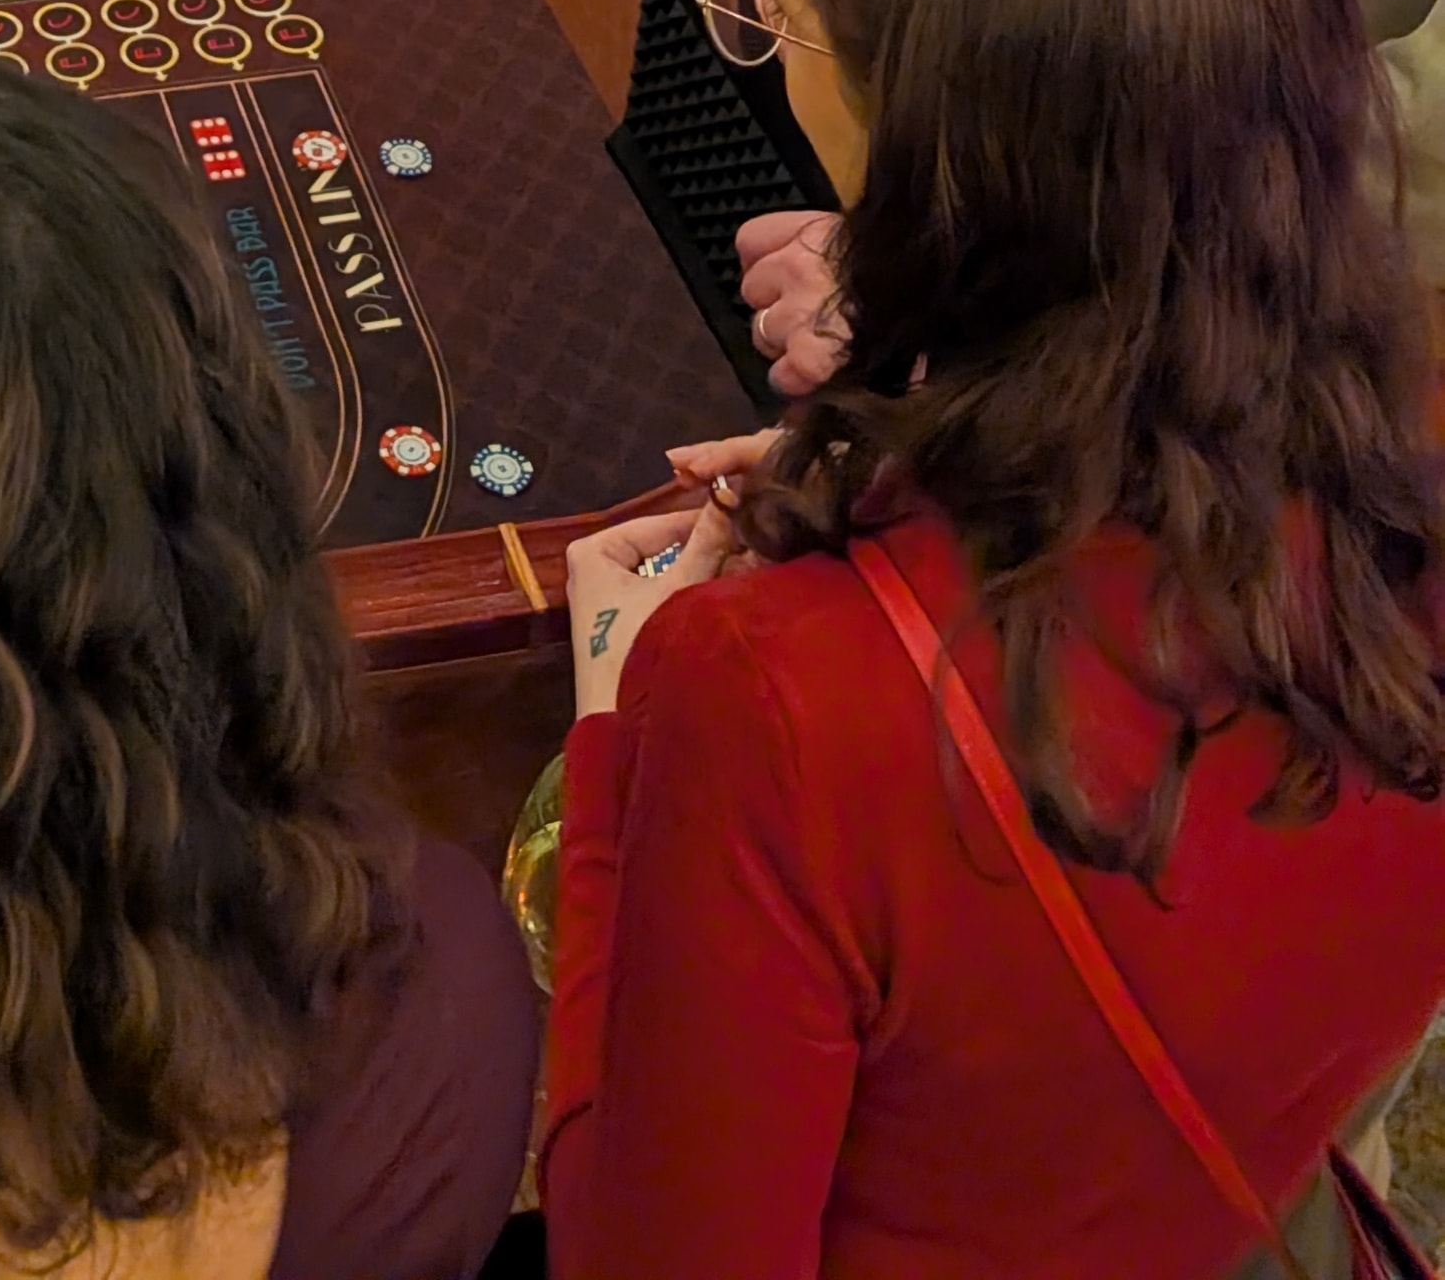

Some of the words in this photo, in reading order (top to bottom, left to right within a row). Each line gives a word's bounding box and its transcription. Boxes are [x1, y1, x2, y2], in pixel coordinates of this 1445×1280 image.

[226, 206, 268, 253] BAR
[242, 257, 288, 311] PASS
[328, 233, 403, 332] PASS
